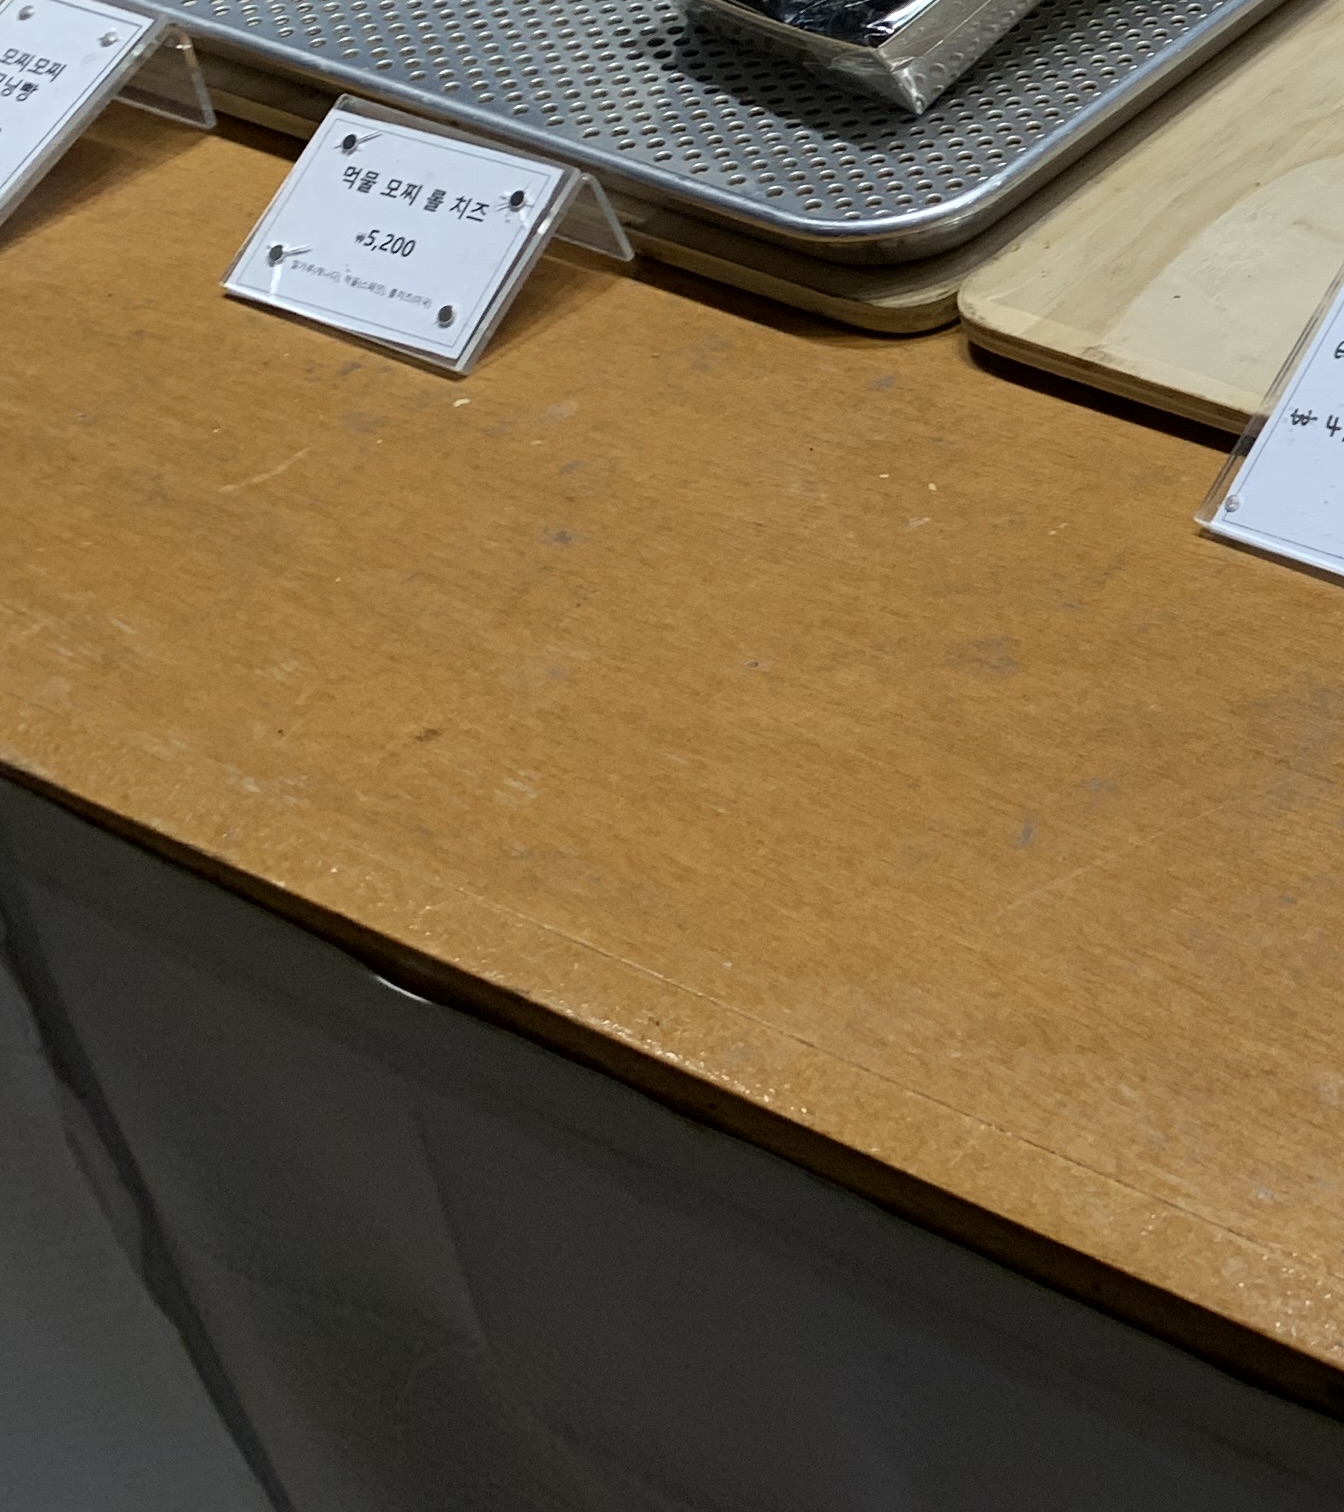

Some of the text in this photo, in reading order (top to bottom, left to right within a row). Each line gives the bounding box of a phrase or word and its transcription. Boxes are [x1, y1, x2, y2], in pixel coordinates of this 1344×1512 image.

[343, 166, 490, 222] 먹물 모찌 롤 치즈
[355, 229, 416, 257] ₩5,200
